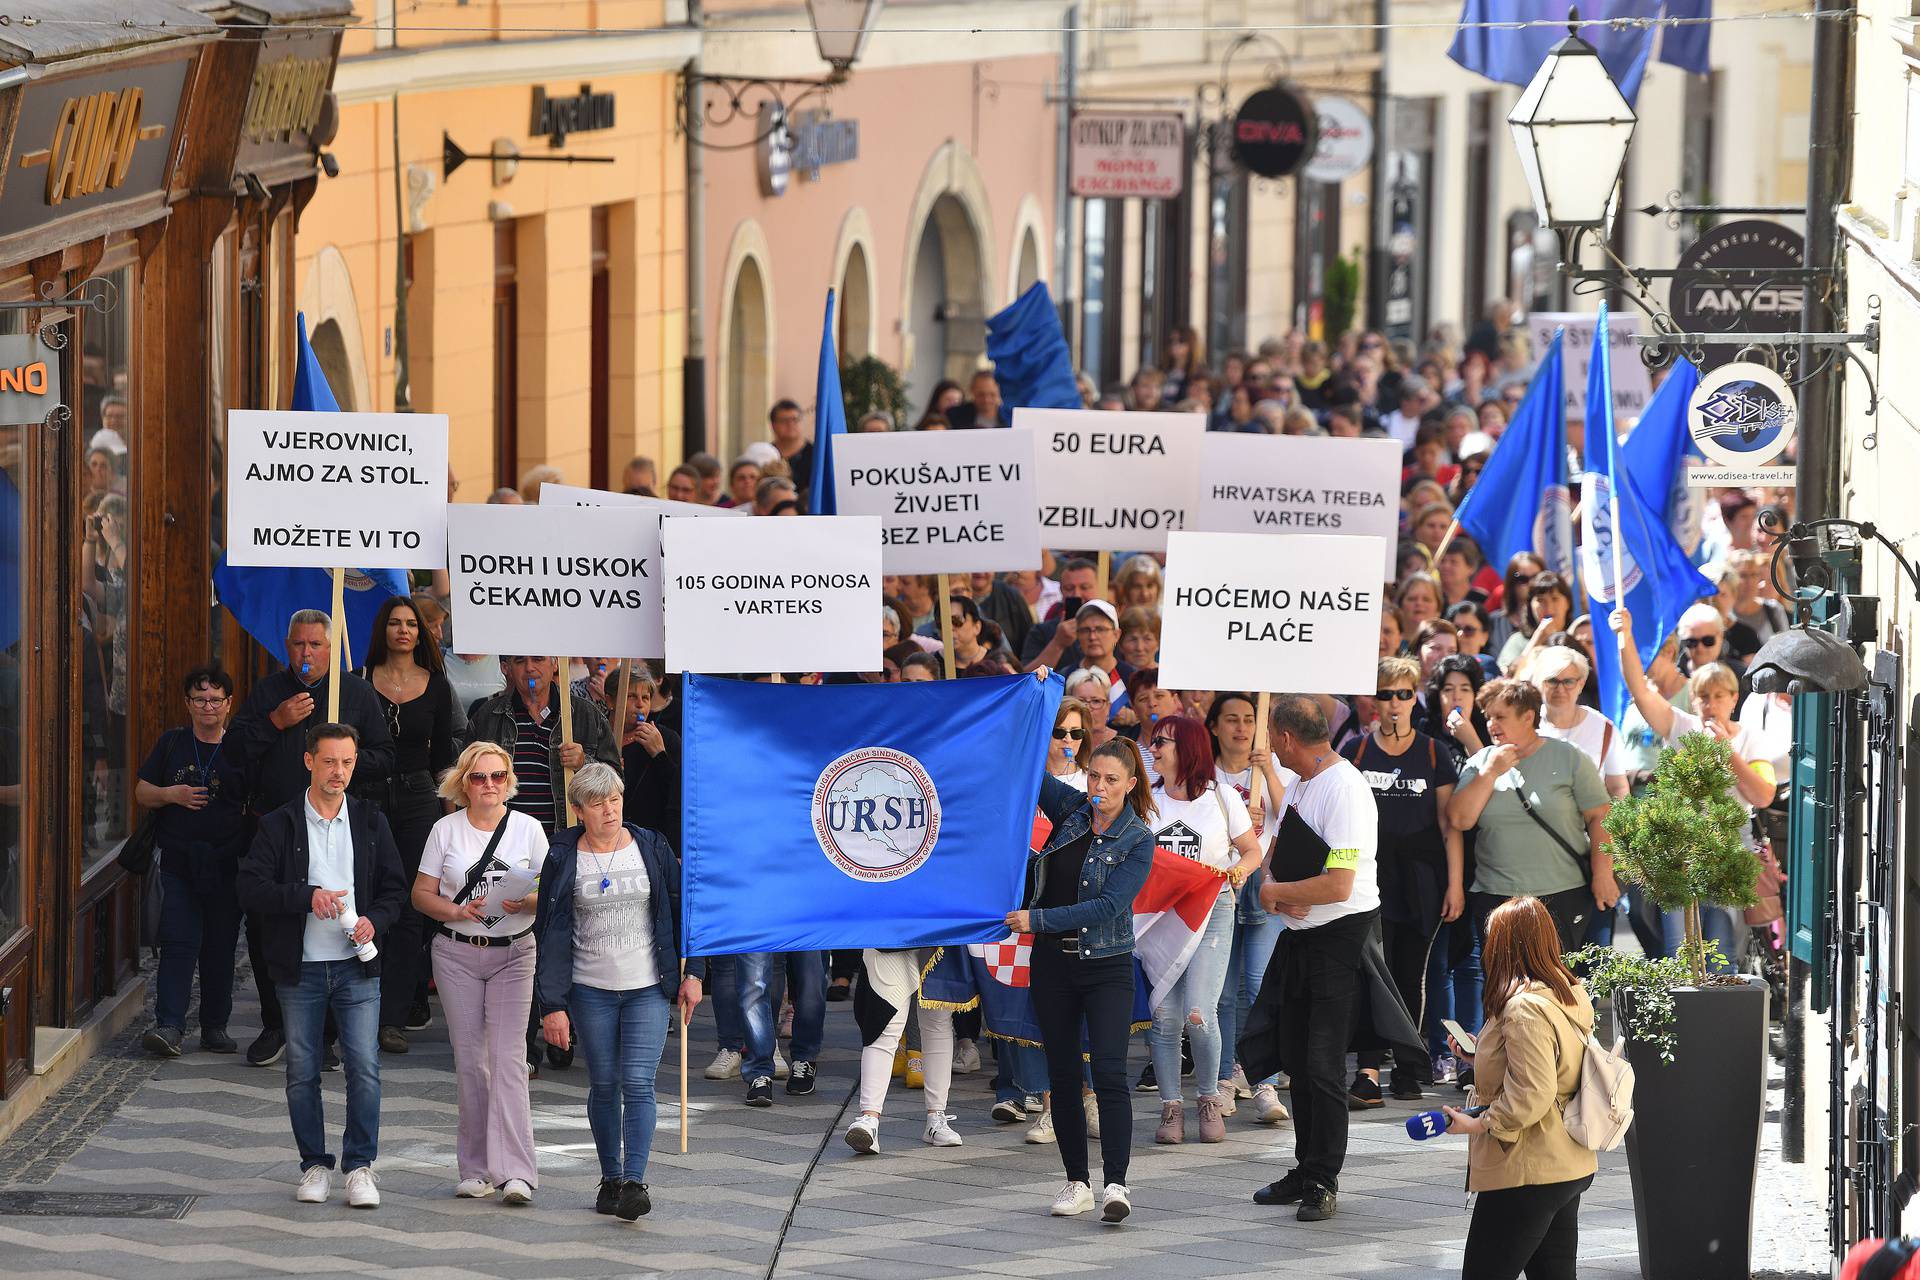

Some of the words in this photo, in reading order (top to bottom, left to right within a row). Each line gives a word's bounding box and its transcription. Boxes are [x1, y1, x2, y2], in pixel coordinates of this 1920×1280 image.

[1237, 121, 1302, 143] DIVA
[1695, 288, 1804, 312] AMOS
[1695, 392, 1795, 424] ODISEA
[262, 430, 413, 456] VJEROVNICI,
[1052, 432, 1080, 453] 50
[1090, 433, 1166, 455] EURA
[245, 462, 315, 483] AJMO
[320, 464, 353, 483] ZA
[360, 465, 429, 485] STOL.
[850, 462, 992, 487] POKUŠAJTE
[999, 463, 1020, 481] VI
[1690, 471, 1794, 481] www.odisea-travel.hr
[894, 492, 979, 514] ŽIVJETI
[1212, 485, 1316, 504] HRVATSKA
[1321, 489, 1385, 507] TREBA
[1253, 510, 1342, 528] VARTEKS
[253, 523, 352, 548] MOŽETE
[358, 530, 381, 549] VI
[388, 530, 421, 549] TO
[926, 520, 1005, 544] PLAĆE
[460, 554, 534, 575] DORH
[542, 556, 548, 576] I
[556, 556, 649, 578] USKOK
[675, 575, 706, 590] 105
[711, 574, 785, 590] GODINA
[791, 574, 871, 589] PONOSA
[469, 581, 582, 608] ČEKAMO
[588, 588, 642, 610] VAS
[734, 599, 823, 615] VARTEKS
[1176, 583, 1291, 610] HOĆEMO
[1299, 586, 1370, 612] NAŠE
[1227, 617, 1314, 643] PLAĆE
[815, 772, 832, 806] UDRUGA
[871, 750, 912, 766] SINDIKATA
[913, 764, 936, 801] HRVATSKE
[828, 796, 926, 832] URSH
[815, 816, 835, 855] WORKERS
[833, 854, 854, 873] TRADE
[854, 869, 878, 879] UNION
[879, 856, 924, 879] ASSOCIATION
[922, 846, 933, 856] OF
[929, 812, 939, 846] CROATIA
